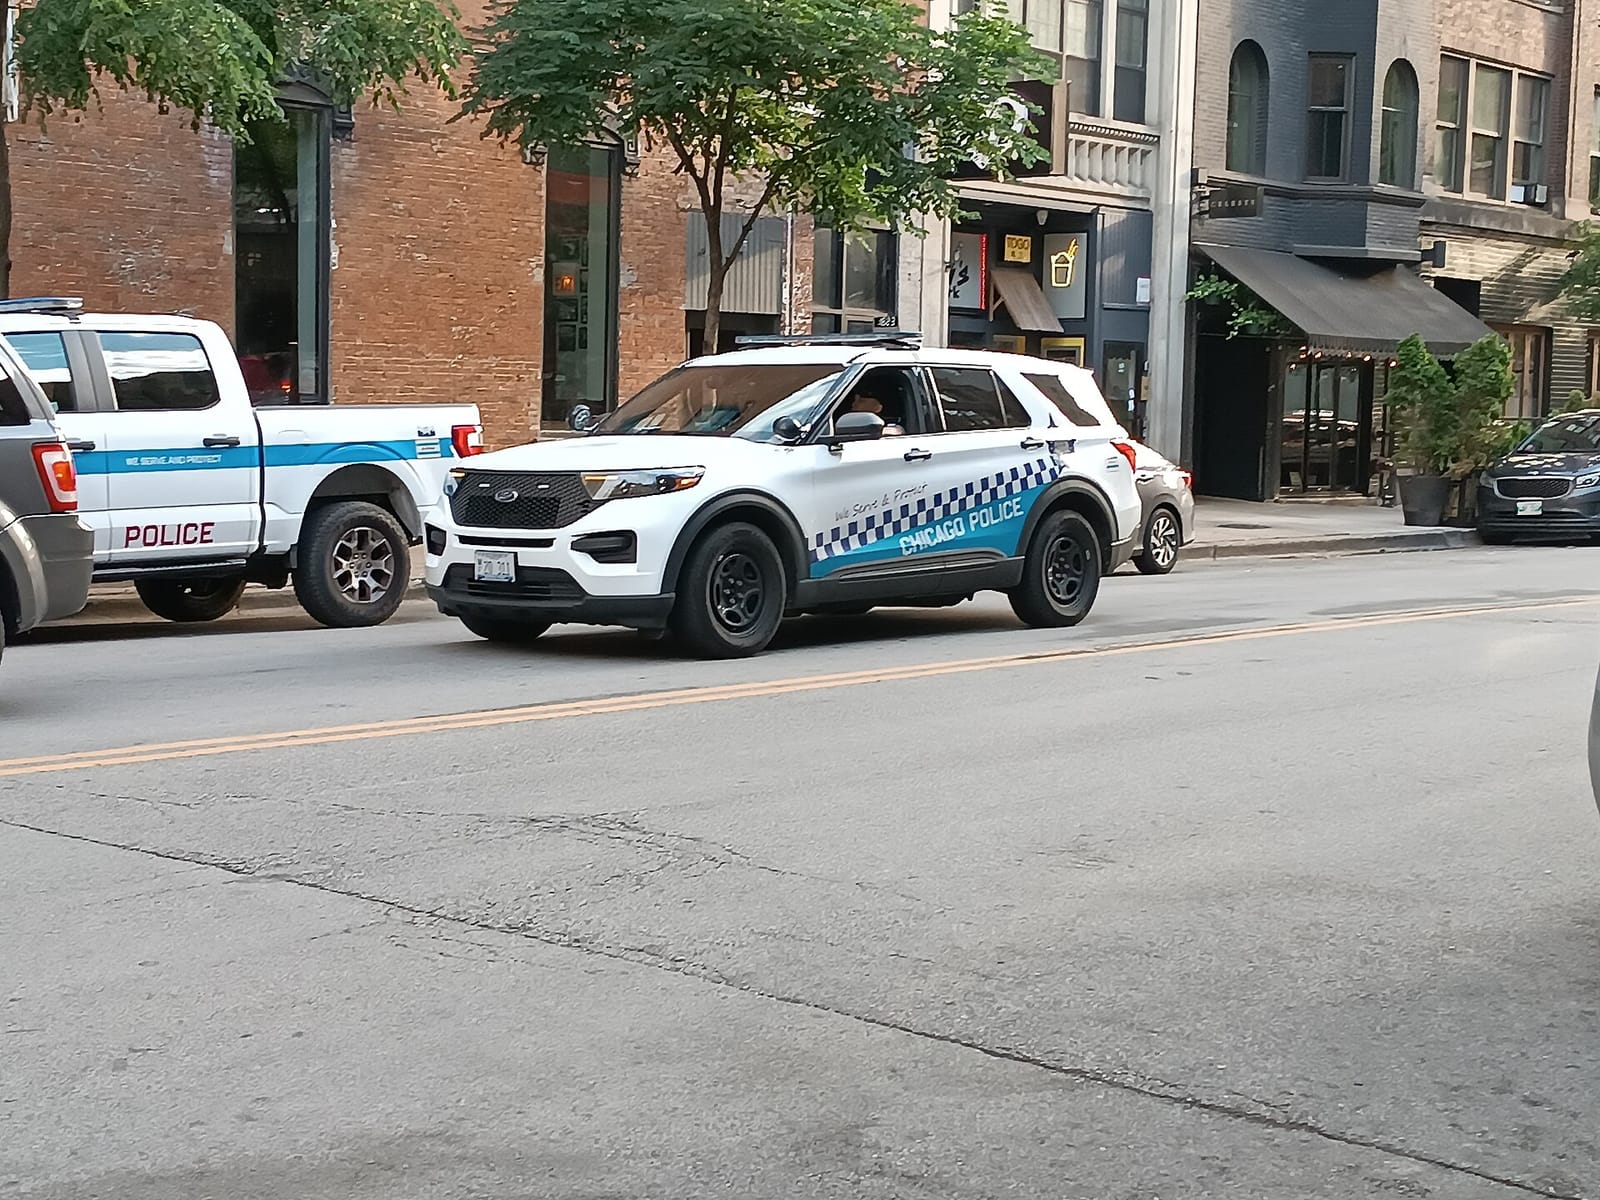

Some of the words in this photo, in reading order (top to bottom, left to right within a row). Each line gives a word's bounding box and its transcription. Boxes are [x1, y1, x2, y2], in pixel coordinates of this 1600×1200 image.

[124, 521, 215, 549] POLICE
[899, 517, 966, 556] CHICAGO
[969, 496, 1025, 532] POLICE
